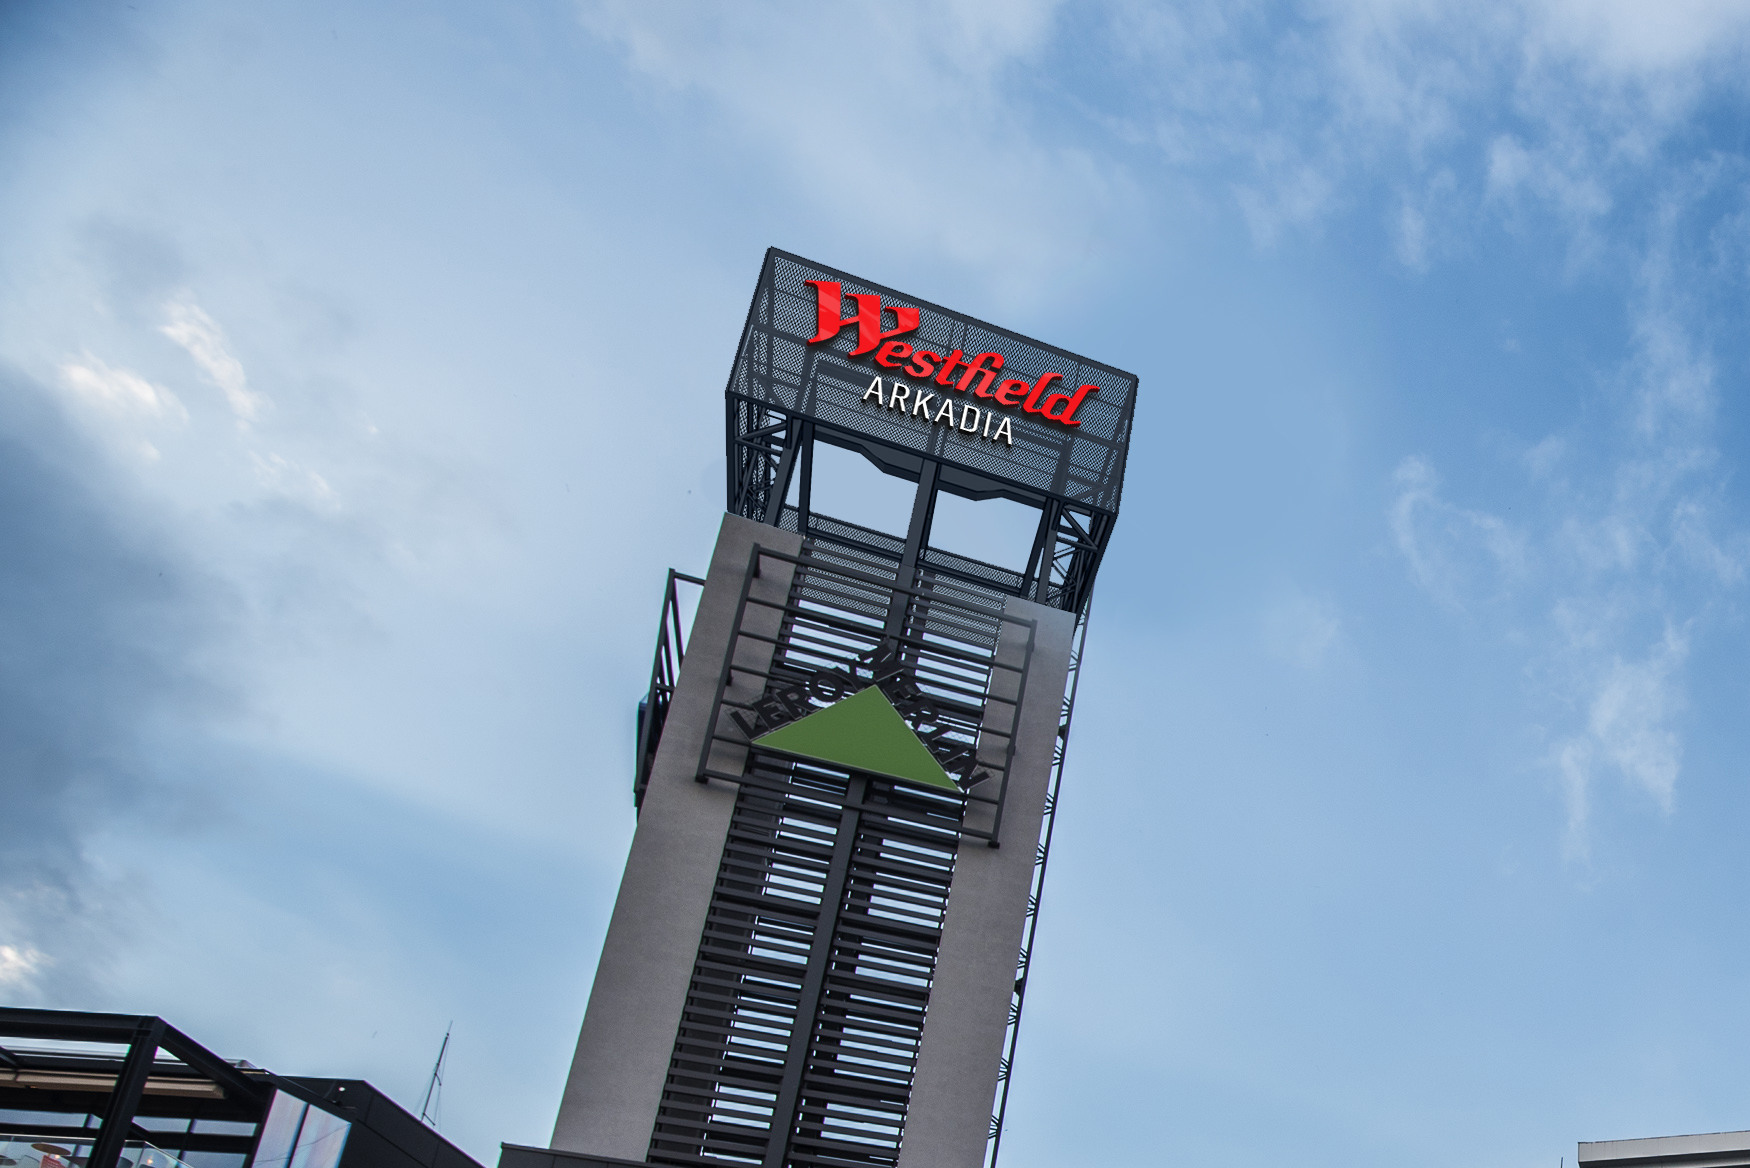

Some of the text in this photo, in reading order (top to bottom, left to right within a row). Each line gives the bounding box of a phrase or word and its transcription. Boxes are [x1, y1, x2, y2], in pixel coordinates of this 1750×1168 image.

[804, 280, 1100, 428] Westfield
[862, 376, 1013, 447] ARKADIA
[730, 640, 990, 791] LEROY MERLIN
